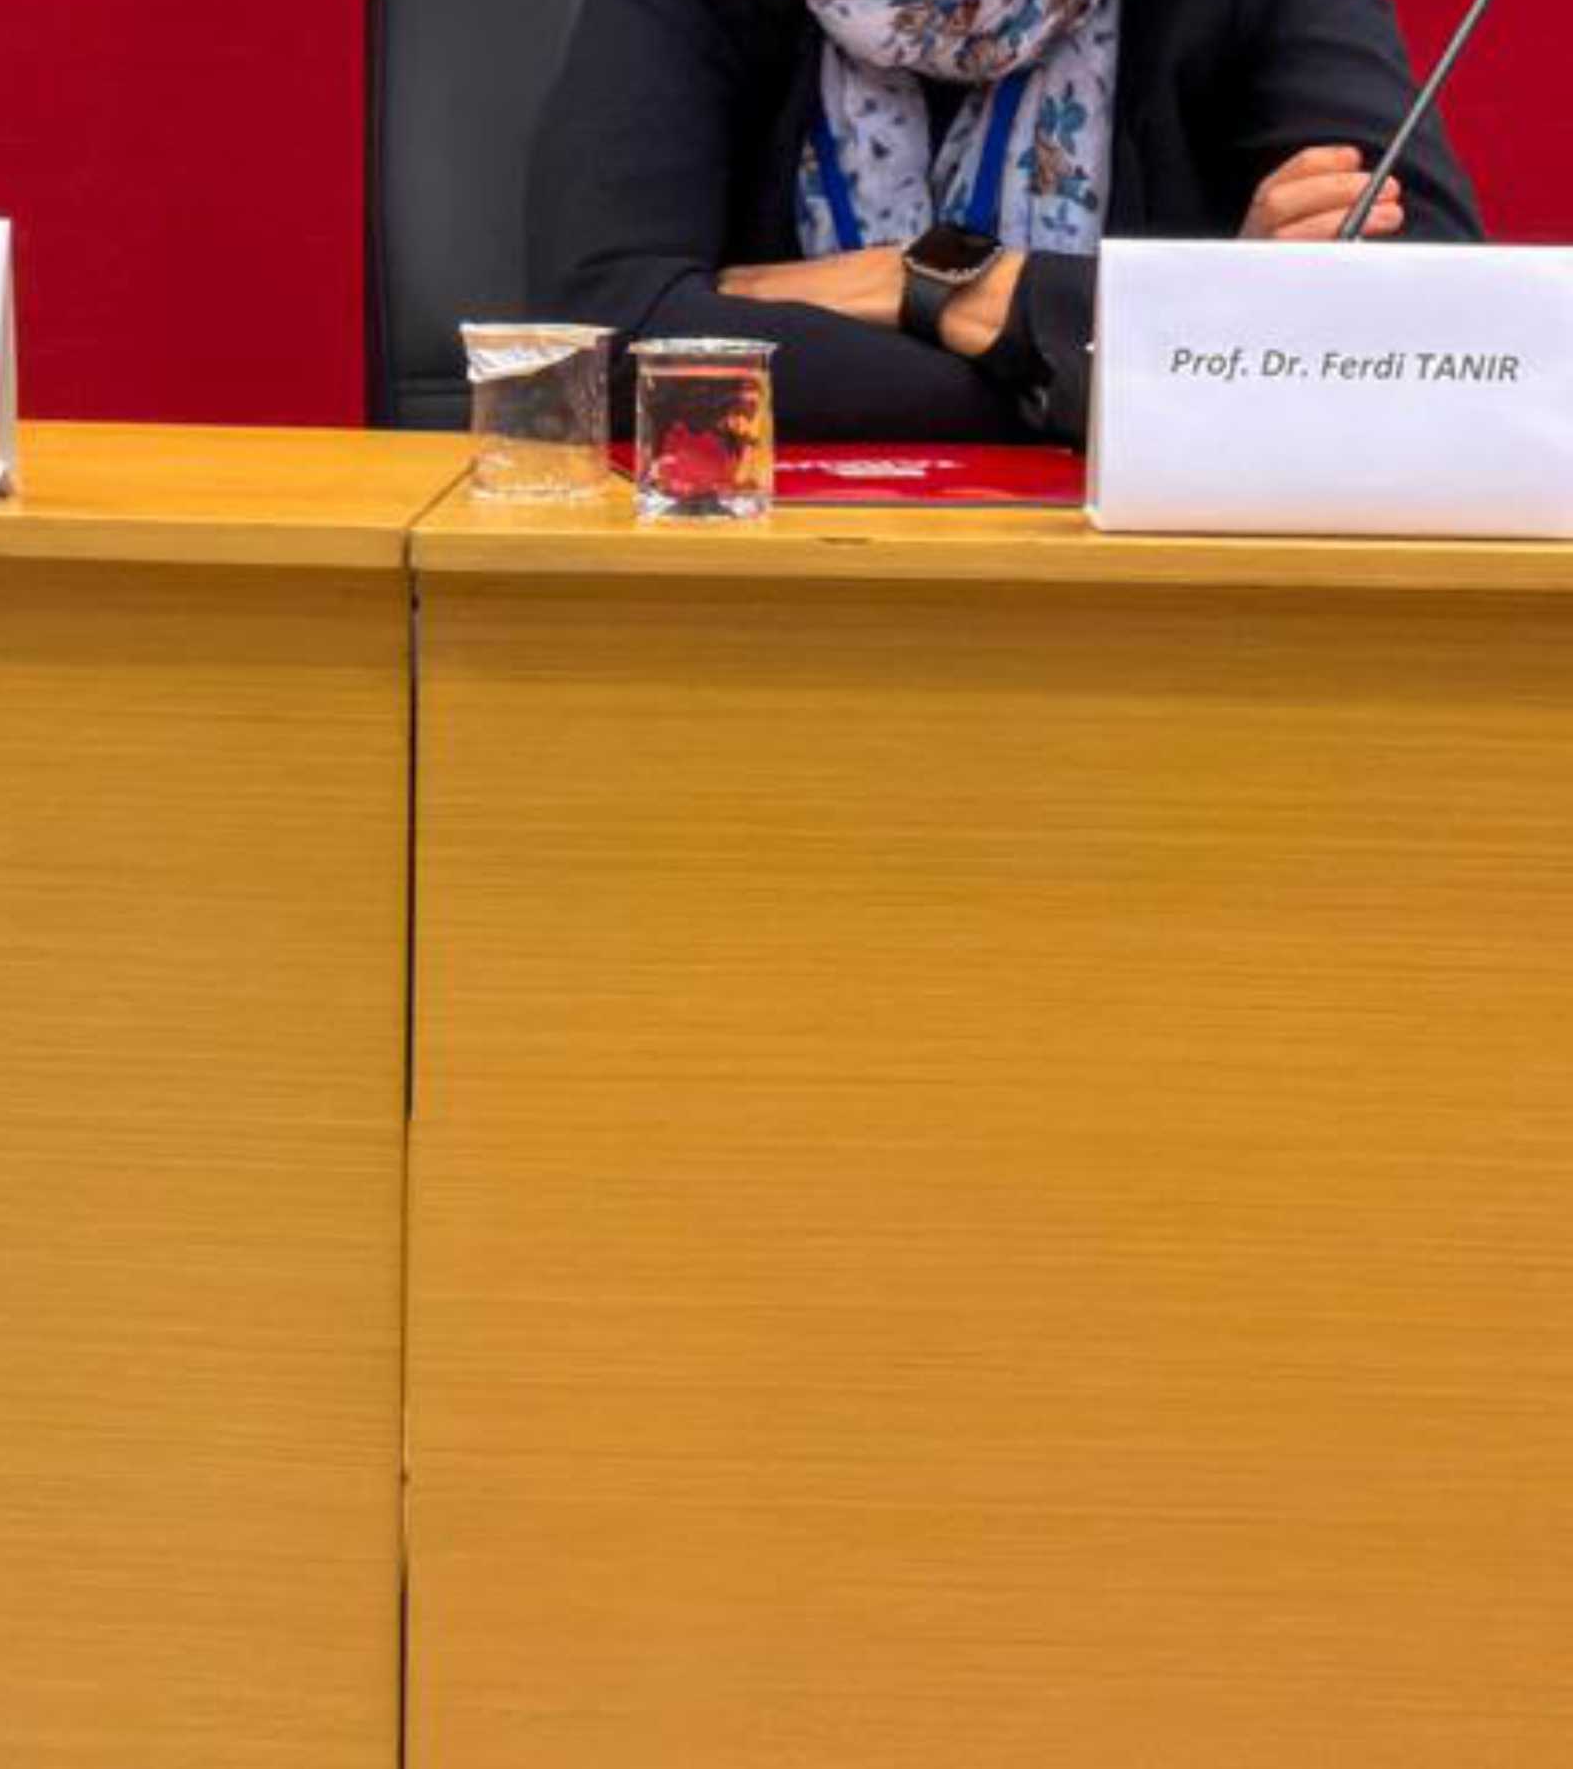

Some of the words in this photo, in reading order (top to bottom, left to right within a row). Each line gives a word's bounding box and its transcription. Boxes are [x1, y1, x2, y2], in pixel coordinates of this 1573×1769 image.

[1170, 347, 1249, 382] Prof.
[1261, 348, 1310, 379] Dr.
[1320, 350, 1405, 381] Ferdi
[1417, 351, 1520, 383] TANIR
